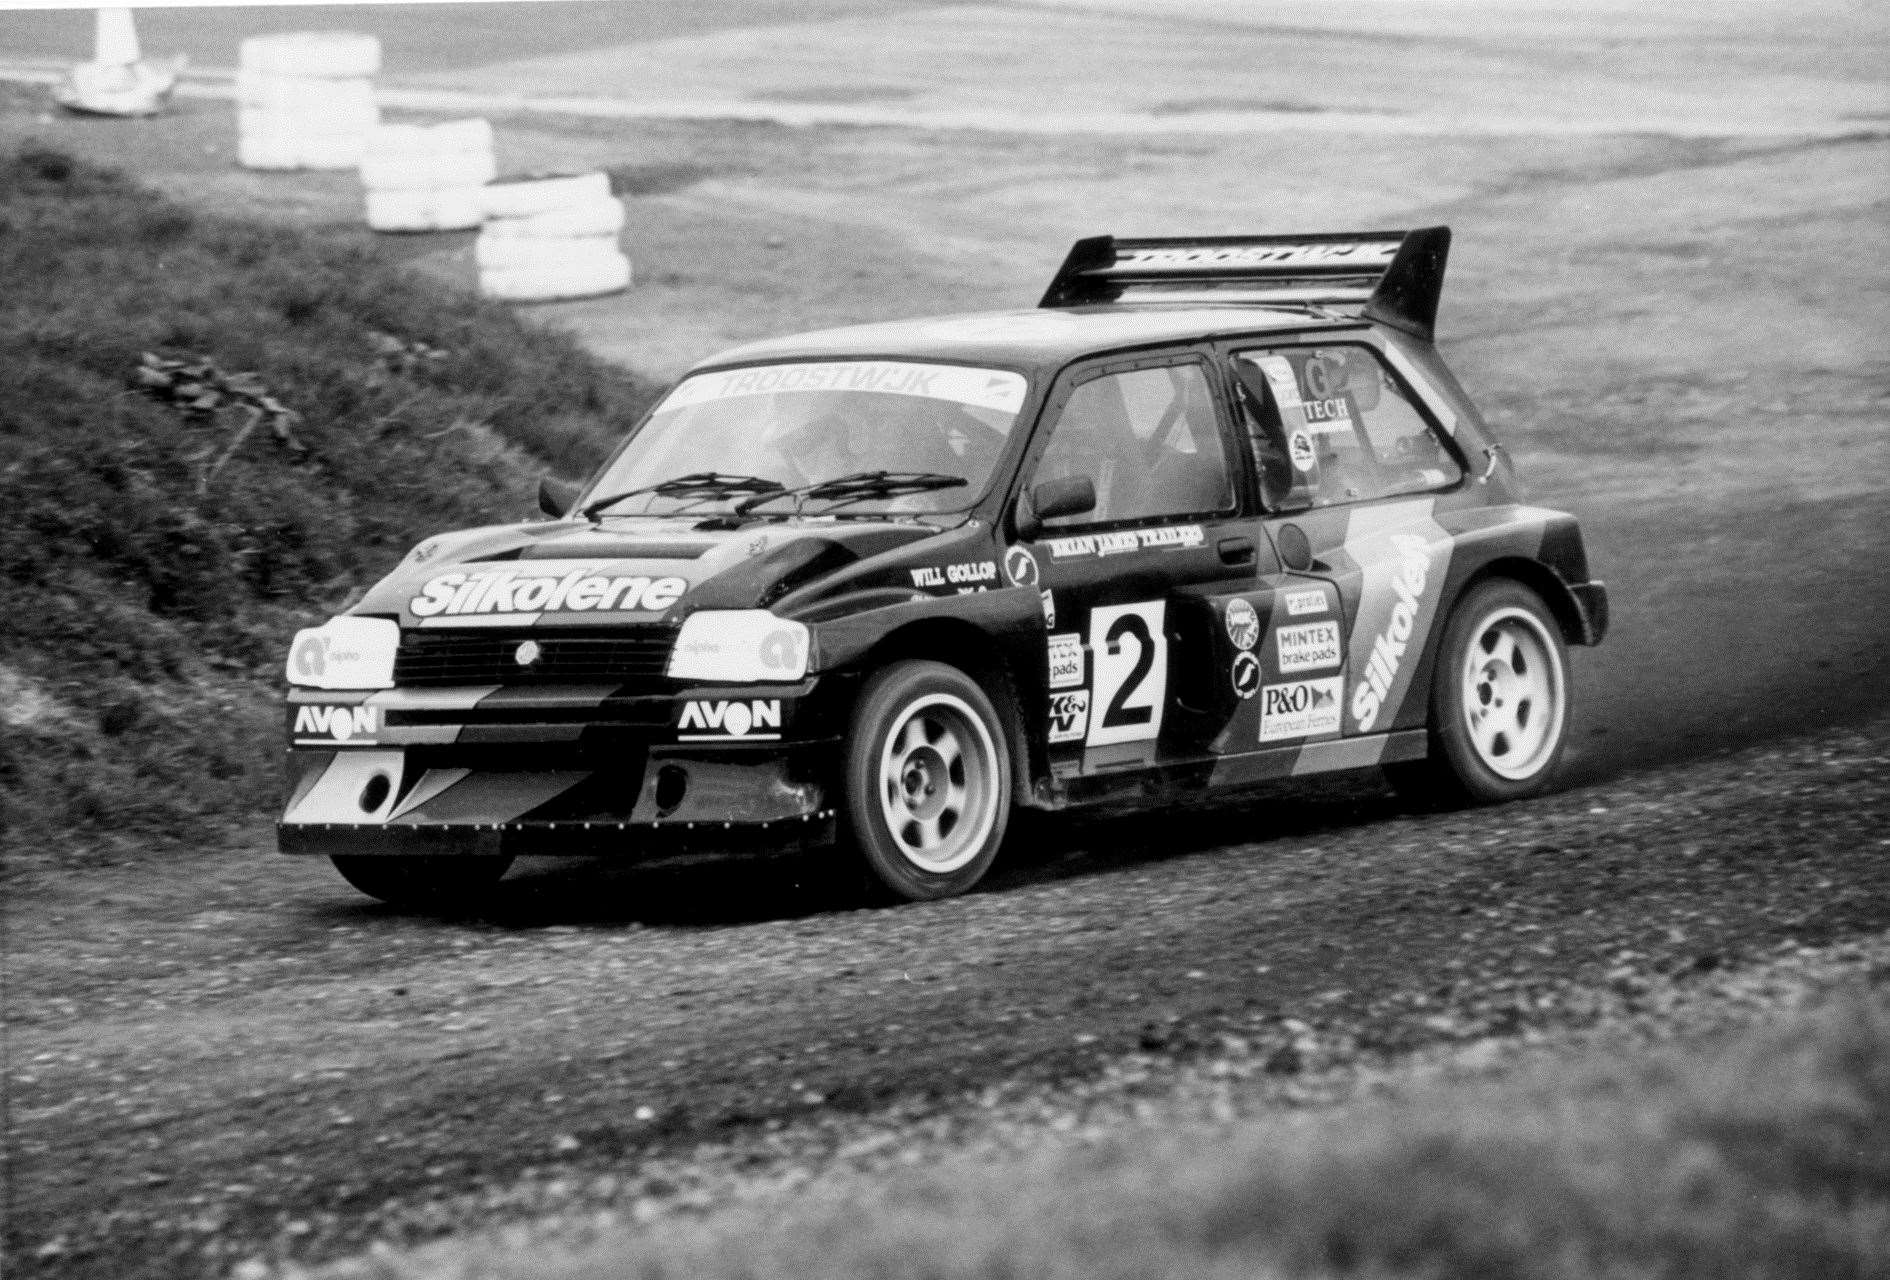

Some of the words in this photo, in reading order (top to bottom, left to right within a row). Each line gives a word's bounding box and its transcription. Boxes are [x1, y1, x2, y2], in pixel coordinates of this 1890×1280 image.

[1303, 398, 1348, 420] TECH
[910, 567, 946, 586] WILL
[947, 561, 996, 583] GOLLOP
[410, 569, 688, 617] Silkolene
[1280, 627, 1335, 648] MINTEX
[1282, 650, 1311, 666] brake
[1312, 646, 1337, 664] pads
[1053, 661, 1078, 680] pads
[1101, 613, 1155, 729] 2
[1265, 685, 1308, 716] P&O
[294, 705, 378, 741] AVON
[677, 699, 782, 736] AVON
